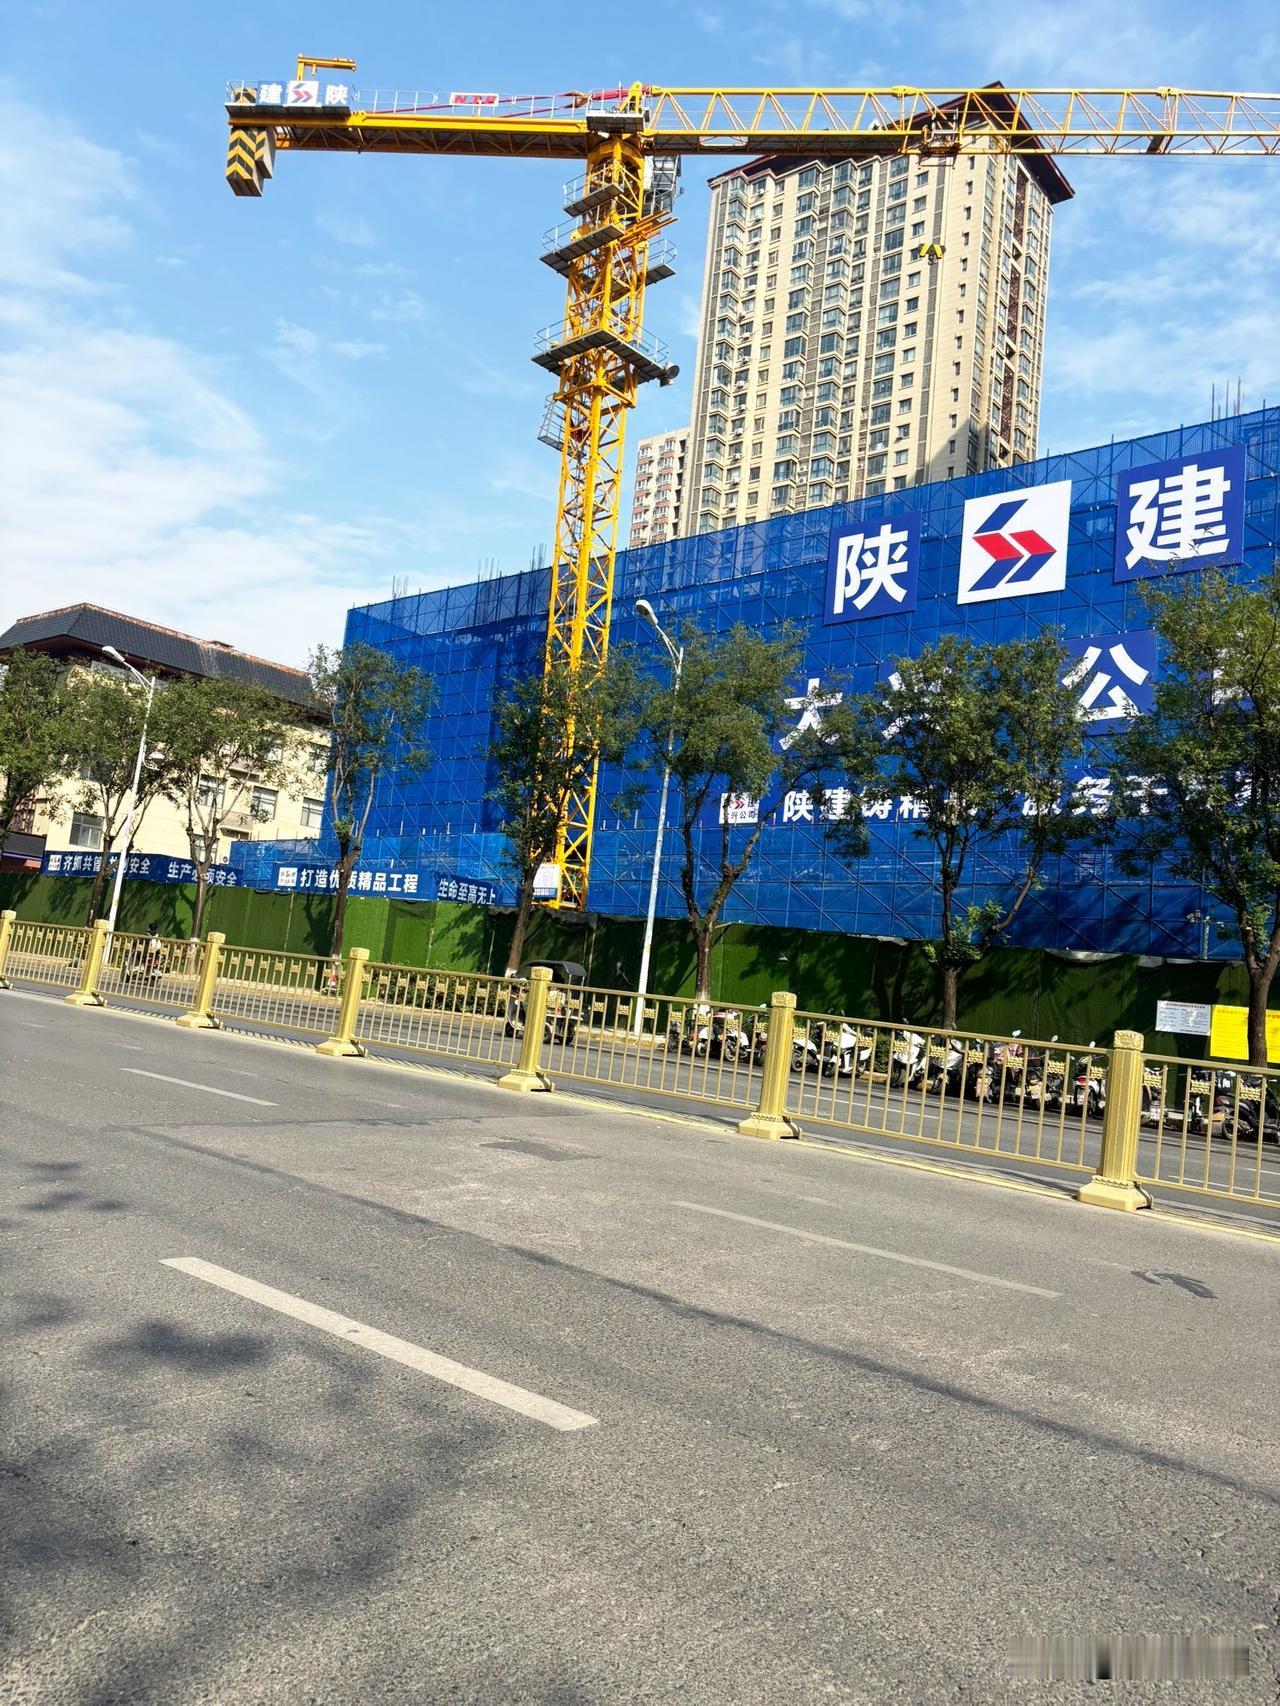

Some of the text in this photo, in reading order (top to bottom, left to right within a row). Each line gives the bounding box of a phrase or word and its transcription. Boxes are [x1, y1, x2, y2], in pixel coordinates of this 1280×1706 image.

[259, 83, 349, 105] 建 陕
[833, 464, 1231, 614] 陕 建
[299, 867, 419, 893] 打造优质精品工程
[437, 877, 497, 905] 生命至高无上
